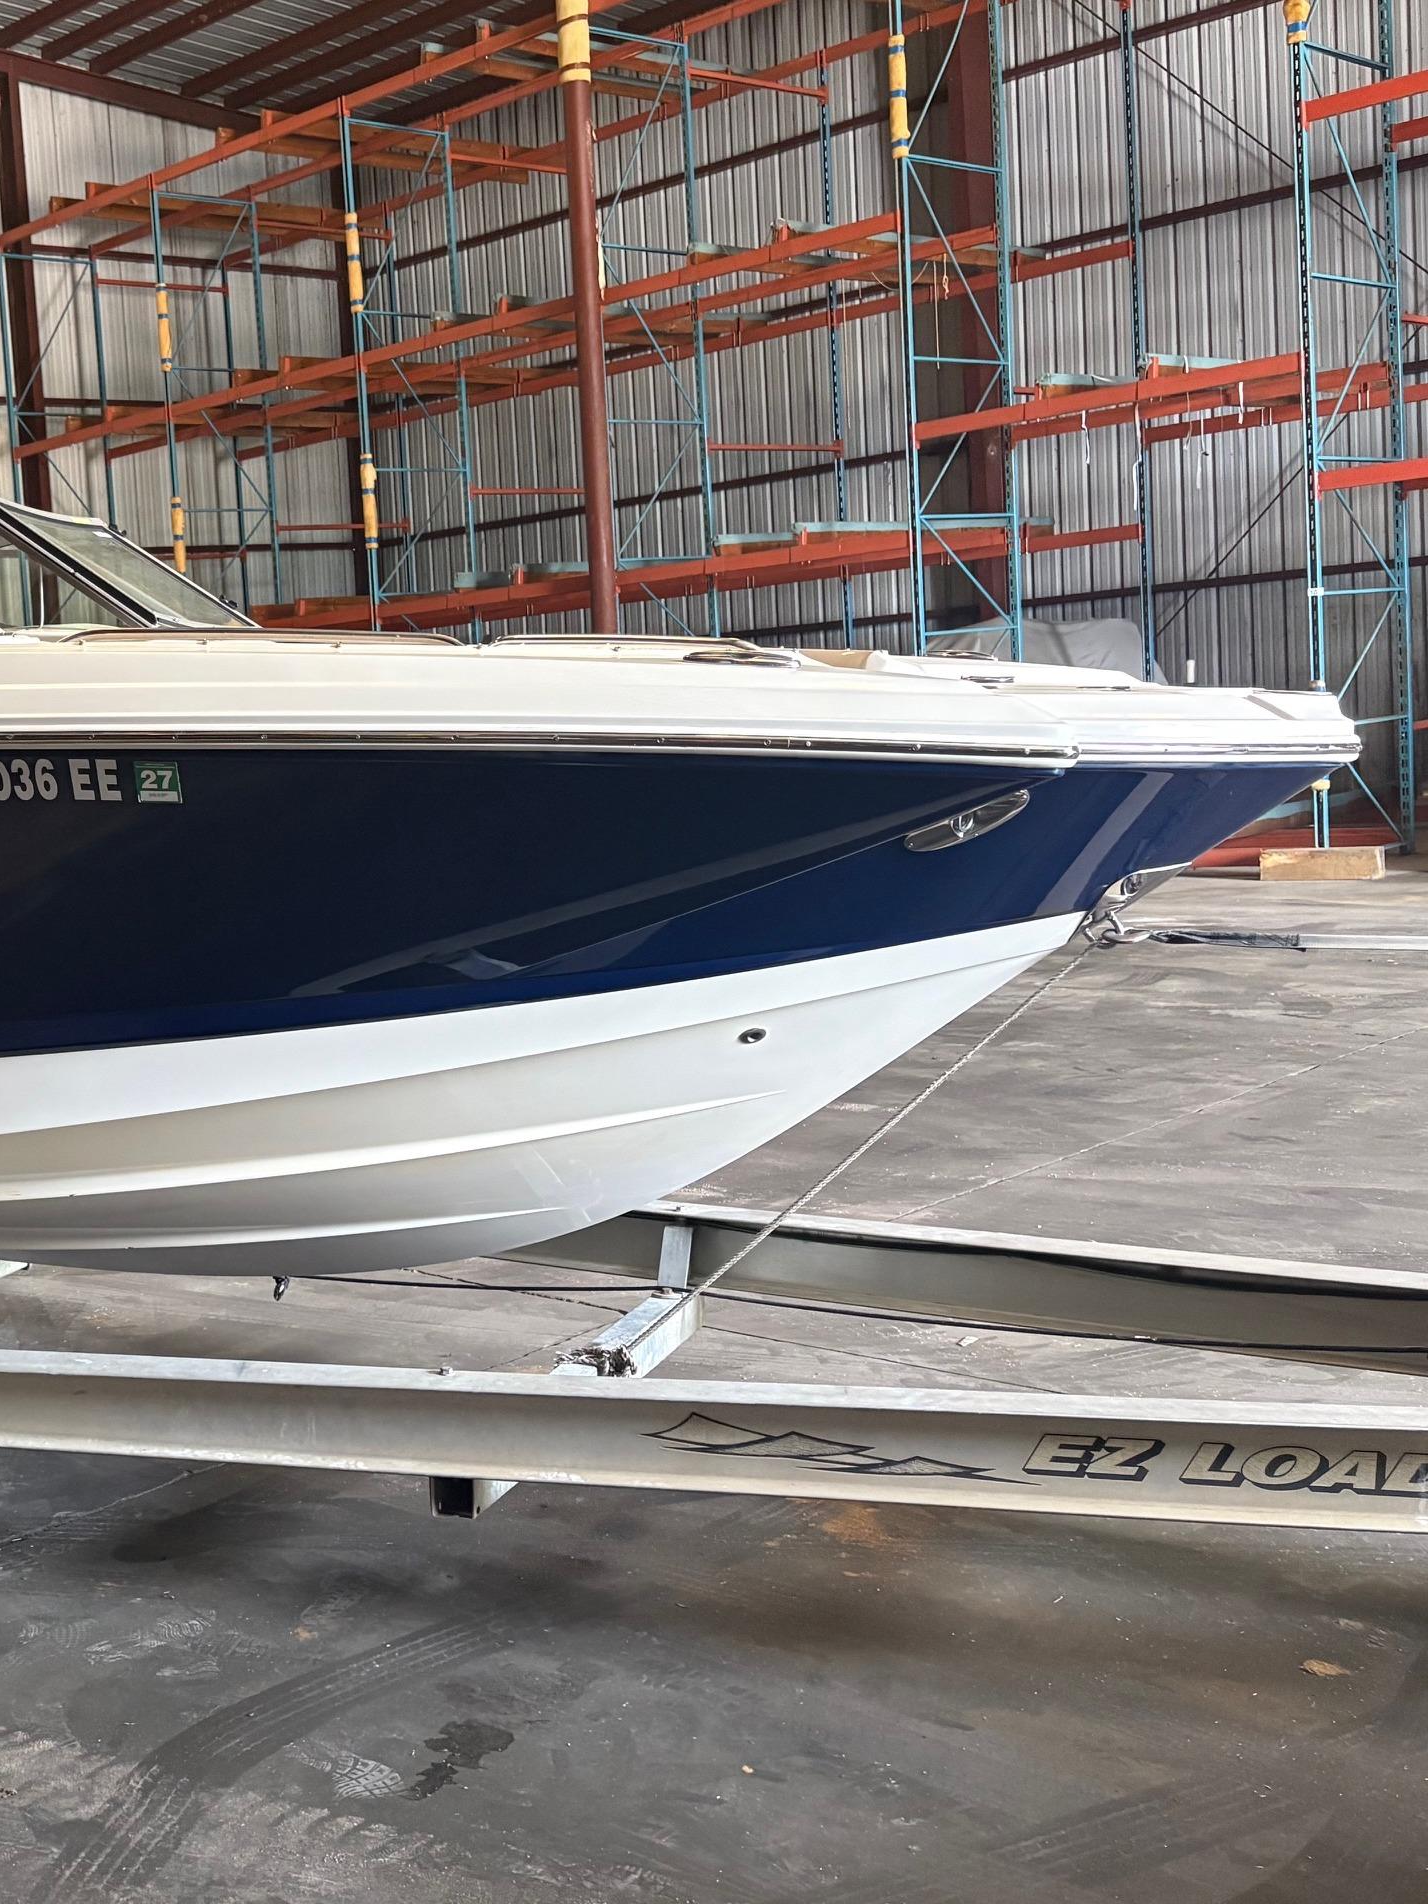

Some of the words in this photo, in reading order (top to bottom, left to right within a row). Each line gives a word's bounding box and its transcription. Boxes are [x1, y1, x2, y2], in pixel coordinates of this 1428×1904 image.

[68, 758, 122, 801] EE
[140, 769, 173, 789] 27
[1022, 1433, 1166, 1482] EZ
